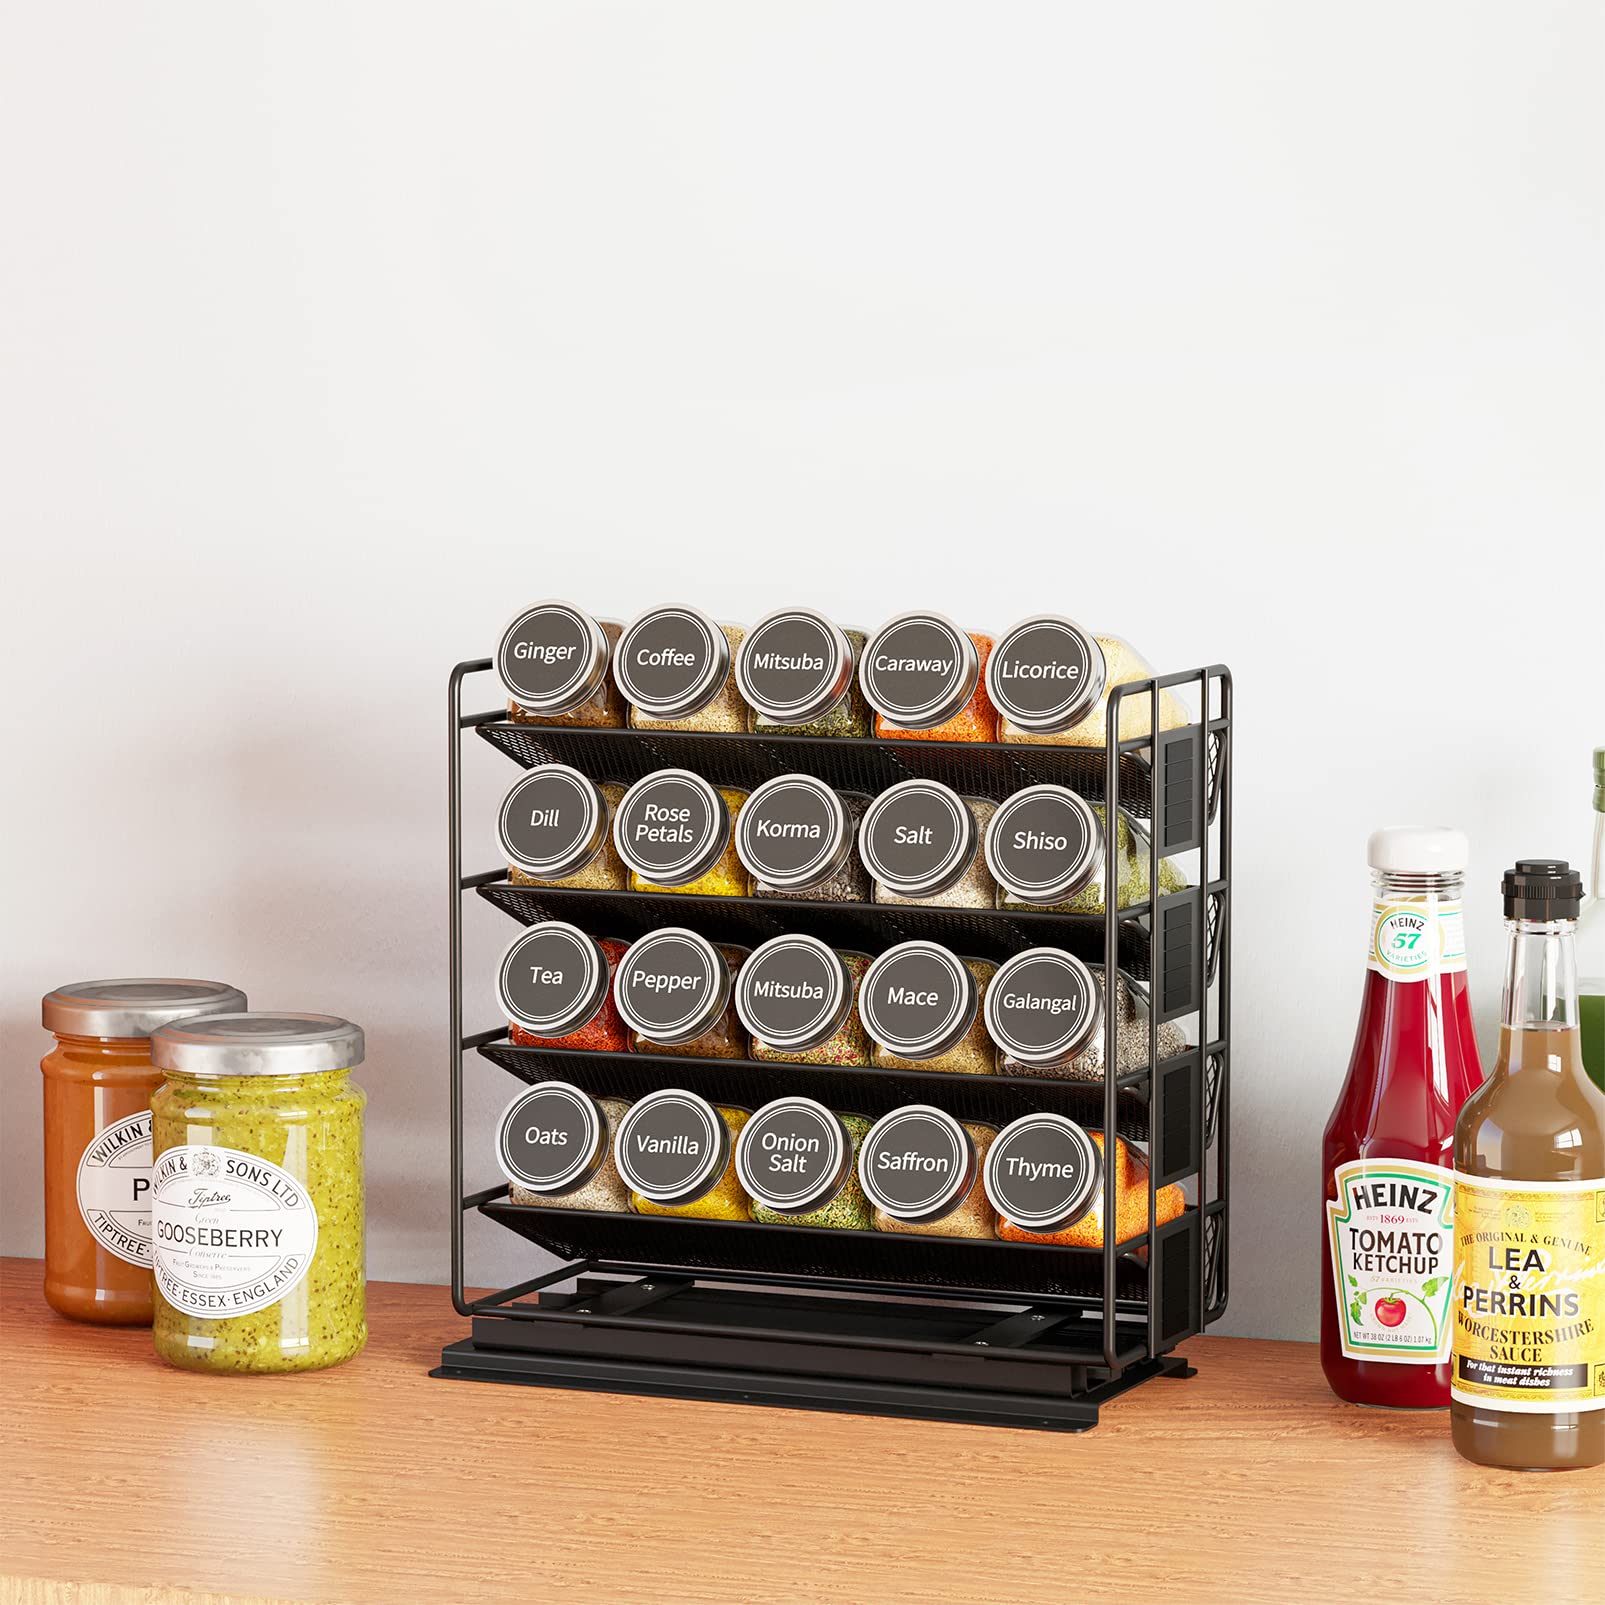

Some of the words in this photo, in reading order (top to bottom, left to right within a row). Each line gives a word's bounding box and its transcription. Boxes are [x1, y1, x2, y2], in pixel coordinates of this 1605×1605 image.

[513, 641, 576, 664] Ginger
[636, 647, 695, 666] Coffee
[753, 652, 823, 670] Mitsuba
[874, 654, 953, 677] Caraway
[1002, 659, 1079, 680] Licorice
[529, 808, 559, 827] Dill
[644, 803, 690, 822] Rose
[634, 823, 693, 843] Petals
[756, 819, 820, 838] Korma
[893, 825, 933, 844] Salt
[1012, 830, 1067, 850] Shiso
[1390, 917, 1424, 931] HEINZ
[1391, 933, 1421, 949] 57
[529, 966, 563, 984] Tea
[632, 971, 701, 993] Pepper
[753, 980, 823, 999] Mitsuba
[887, 986, 938, 1006] Mace
[1003, 992, 1076, 1014] Galangal
[92, 1123, 144, 1163] WILKIN
[524, 1126, 568, 1145] Oats
[636, 1134, 699, 1155] Vanilla
[761, 1132, 819, 1152] Onion
[768, 1153, 807, 1173] Salt
[877, 1151, 948, 1172] Saffron
[1005, 1156, 1073, 1181] Thyme
[179, 1156, 188, 1171] &
[226, 1159, 272, 1187] SONS
[272, 1179, 299, 1207] LTD
[1352, 1183, 1438, 1215] HEINZ
[1380, 1214, 1405, 1224] 1869
[157, 1219, 283, 1248] GOOSEBERRY
[1349, 1228, 1443, 1255] TOMATO
[1460, 1233, 1474, 1247] THE
[1476, 1232, 1526, 1243] ORIGINAL
[1530, 1234, 1538, 1243] &
[1543, 1235, 1592, 1256] GENUINE
[1353, 1252, 1439, 1274] KETCHUP
[1489, 1246, 1545, 1272] LEA
[182, 1289, 227, 1308] ESSEX
[233, 1257, 299, 1306] ENGLAND
[1508, 1275, 1521, 1290] &
[1463, 1285, 1579, 1317] PERRINS
[1353, 1331, 1361, 1339] NET
[1362, 1332, 1370, 1340] WT
[1458, 1310, 1594, 1345] WORCESTERSHIRE
[1490, 1345, 1542, 1362] SAUCE
[1466, 1360, 1478, 1370] For
[1479, 1361, 1496, 1373] that
[1497, 1364, 1532, 1376] instant
[1533, 1365, 1574, 1377] richness
[1483, 1373, 1492, 1382] in
[1494, 1375, 1518, 1385] meat
[1519, 1376, 1551, 1387] dishes
